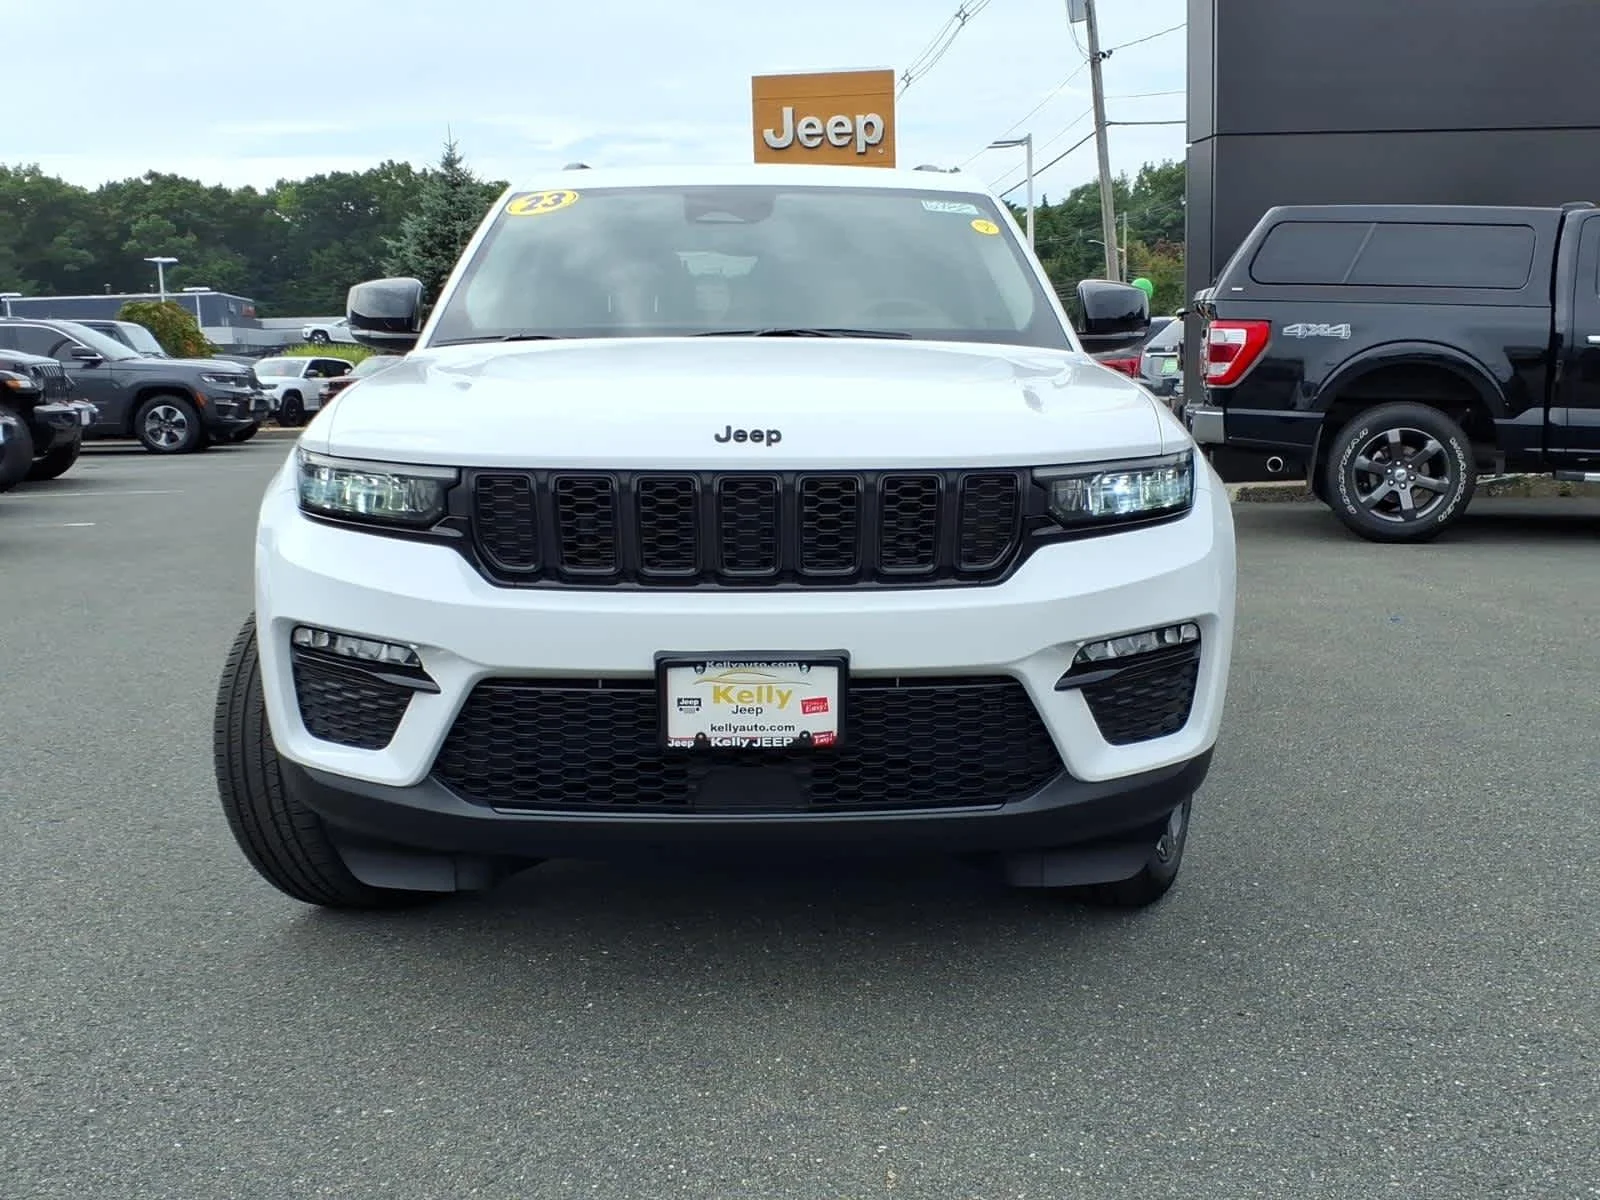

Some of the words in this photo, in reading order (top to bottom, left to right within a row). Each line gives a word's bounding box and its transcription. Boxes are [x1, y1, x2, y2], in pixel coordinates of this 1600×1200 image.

[763, 106, 884, 153] Jeep
[520, 192, 567, 212] 23
[1282, 323, 1352, 340] 4x4
[714, 425, 782, 447] Jeep
[680, 698, 699, 706] Jeep
[712, 685, 793, 709] Kelly
[731, 705, 764, 716] Jeep
[710, 723, 796, 734] kellyauto.com
[667, 738, 695, 748] Jeep
[711, 737, 750, 748] Kelly
[753, 737, 794, 747] JEEP
